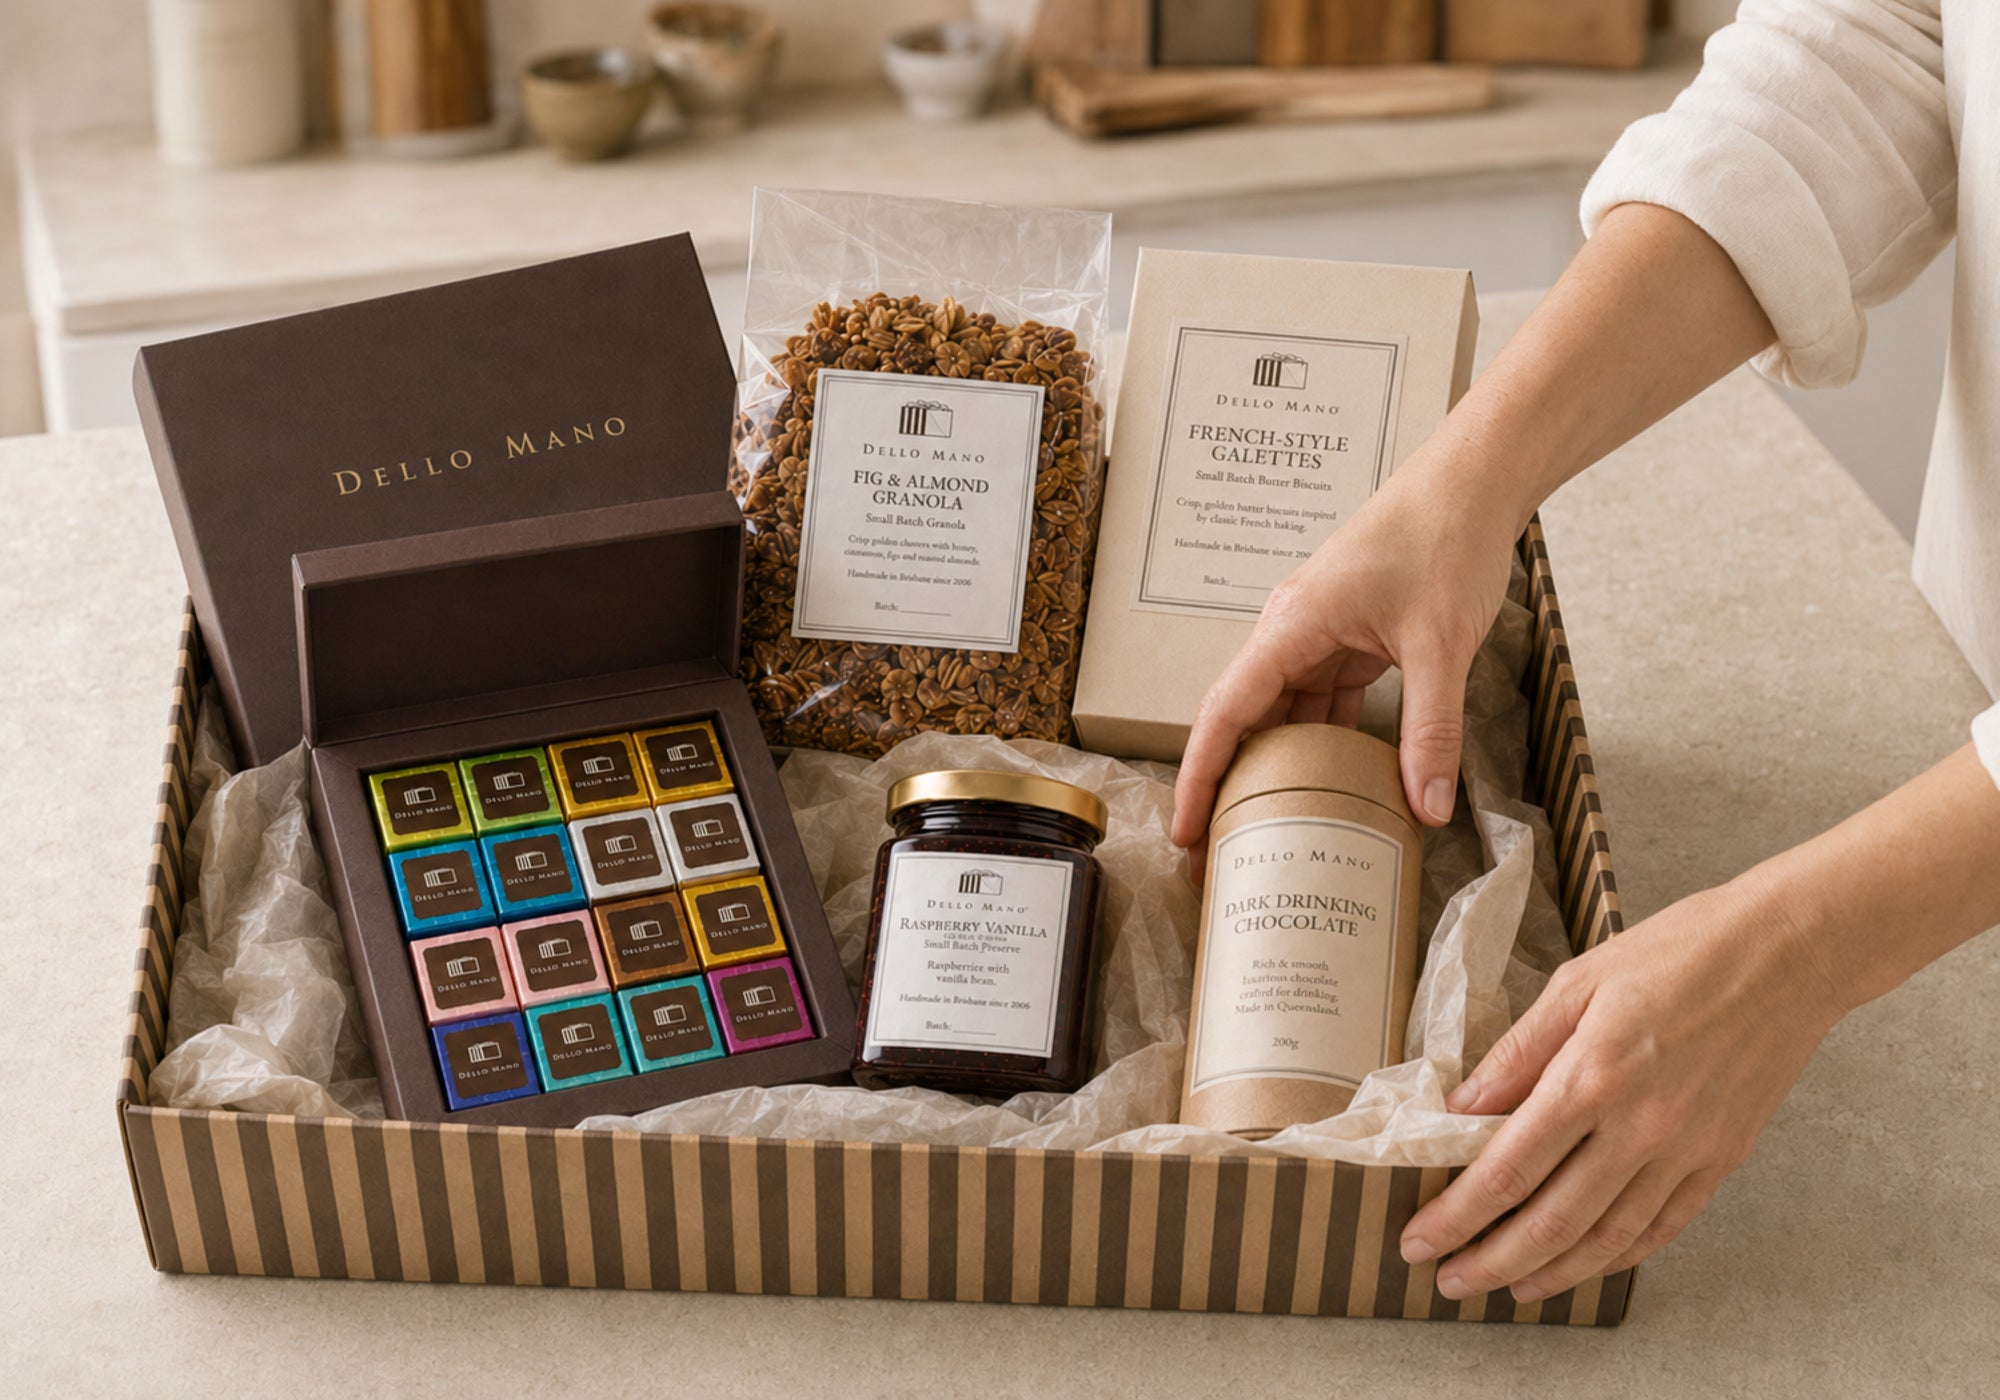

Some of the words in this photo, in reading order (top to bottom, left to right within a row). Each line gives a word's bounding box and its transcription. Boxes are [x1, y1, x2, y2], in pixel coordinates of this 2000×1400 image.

[1216, 395, 1273, 409] DELLO
[1285, 401, 1340, 415] MANO
[1189, 425, 1349, 452] FRENCH-STYLE
[333, 450, 472, 496] DELLO
[505, 417, 626, 459] MANO
[863, 444, 920, 458] DELLO
[932, 450, 985, 463] MANO
[1212, 446, 1322, 469] GALETTES
[854, 471, 883, 486] FIG
[887, 474, 901, 487] &
[906, 476, 989, 494] ALMOND
[1195, 470, 1224, 482] Small
[1227, 472, 1255, 485] Batch
[1293, 478, 1332, 491] Biscuits
[873, 490, 963, 510] GRANOLA
[866, 513, 894, 525] Small
[896, 515, 924, 527] Batch
[926, 518, 966, 531] Granola
[1196, 513, 1208, 524] by
[1240, 516, 1271, 529] French
[932, 540, 950, 550] with
[1175, 538, 1220, 551] Handmade
[1223, 542, 1232, 552] in
[1295, 549, 1313, 559] 200
[902, 553, 916, 561] and
[848, 570, 888, 580] Handmade
[890, 573, 898, 581] in
[953, 577, 972, 586] 2006
[1234, 851, 1294, 870] DELLO
[927, 900, 973, 910] DELLO
[1224, 895, 1271, 918] DARK
[1277, 894, 1376, 921] DRINKING
[985, 922, 1047, 938] VANILLA
[1234, 915, 1359, 937] CHOCOLATE
[924, 940, 950, 949] Small
[952, 941, 978, 951] Batch
[980, 944, 1021, 954] Preserve
[987, 964, 1010, 974] with
[1252, 960, 1276, 970] Rich
[1278, 960, 1288, 969] &
[1291, 960, 1329, 971] smooth
[1290, 975, 1338, 987] chocolate
[1275, 986, 1291, 998] for
[900, 993, 941, 1003] Handmade
[944, 996, 951, 1004] in
[1011, 1001, 1030, 1010] 2006
[1235, 1003, 1261, 1015] Made
[1264, 1002, 1274, 1012] in
[1272, 1037, 1299, 1050] 200g
